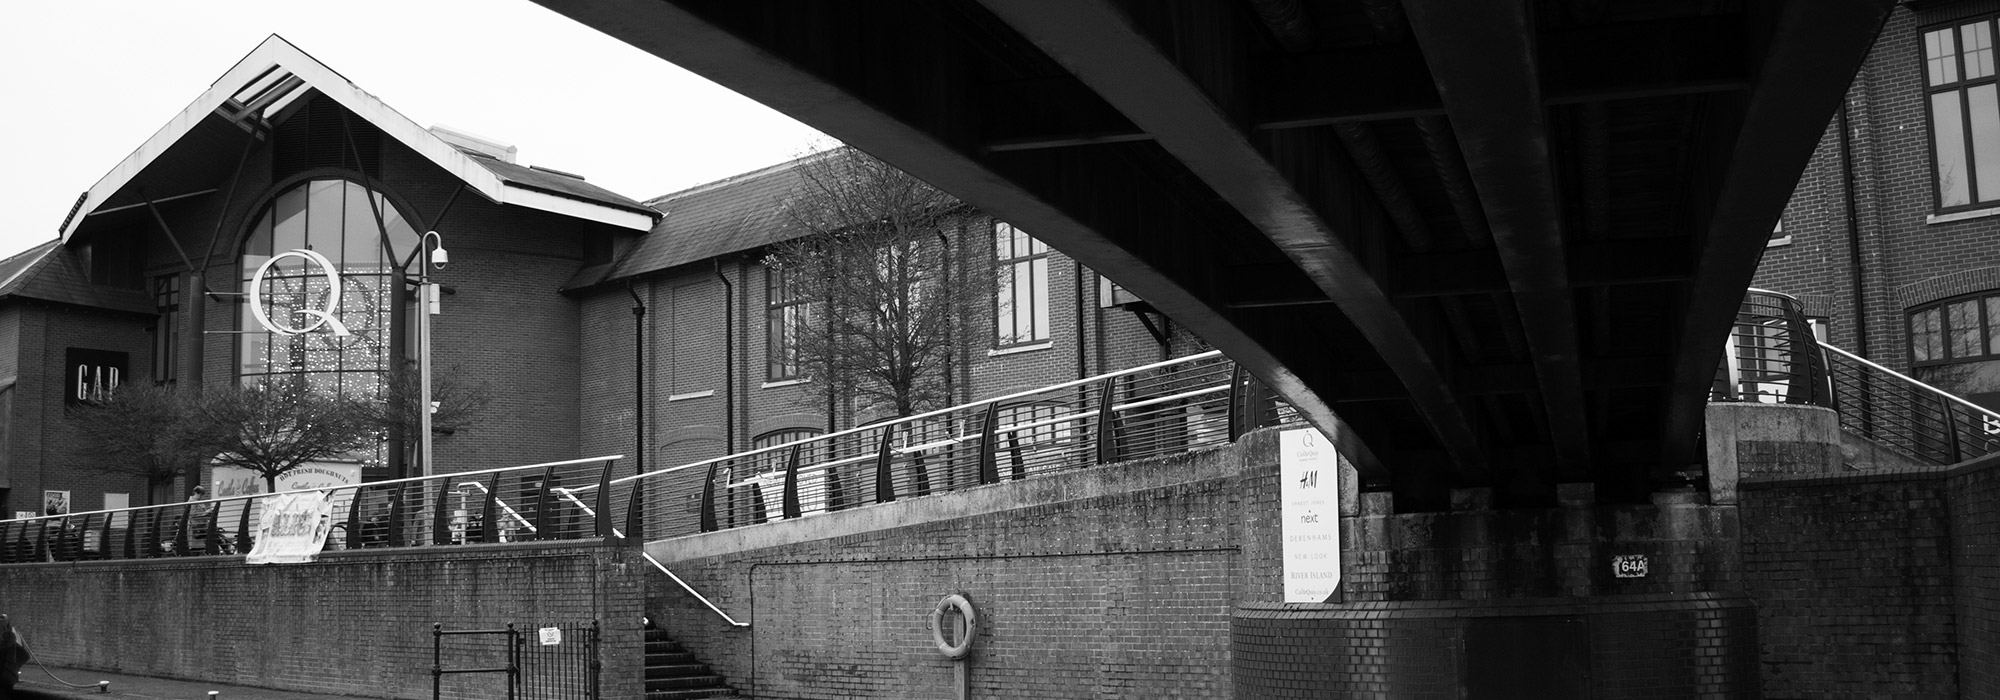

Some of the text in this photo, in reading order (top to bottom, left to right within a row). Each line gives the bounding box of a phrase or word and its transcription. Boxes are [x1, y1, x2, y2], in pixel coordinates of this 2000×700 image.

[78, 364, 119, 401] GAP
[279, 468, 349, 484] HOT FRESH DOUGHNUTS
[1300, 470, 1318, 489] H&M
[1300, 513, 1319, 524] next
[1289, 534, 1332, 542] DEBENHAMS
[1310, 552, 1328, 560] LOOK
[1622, 560, 1645, 572] 64A
